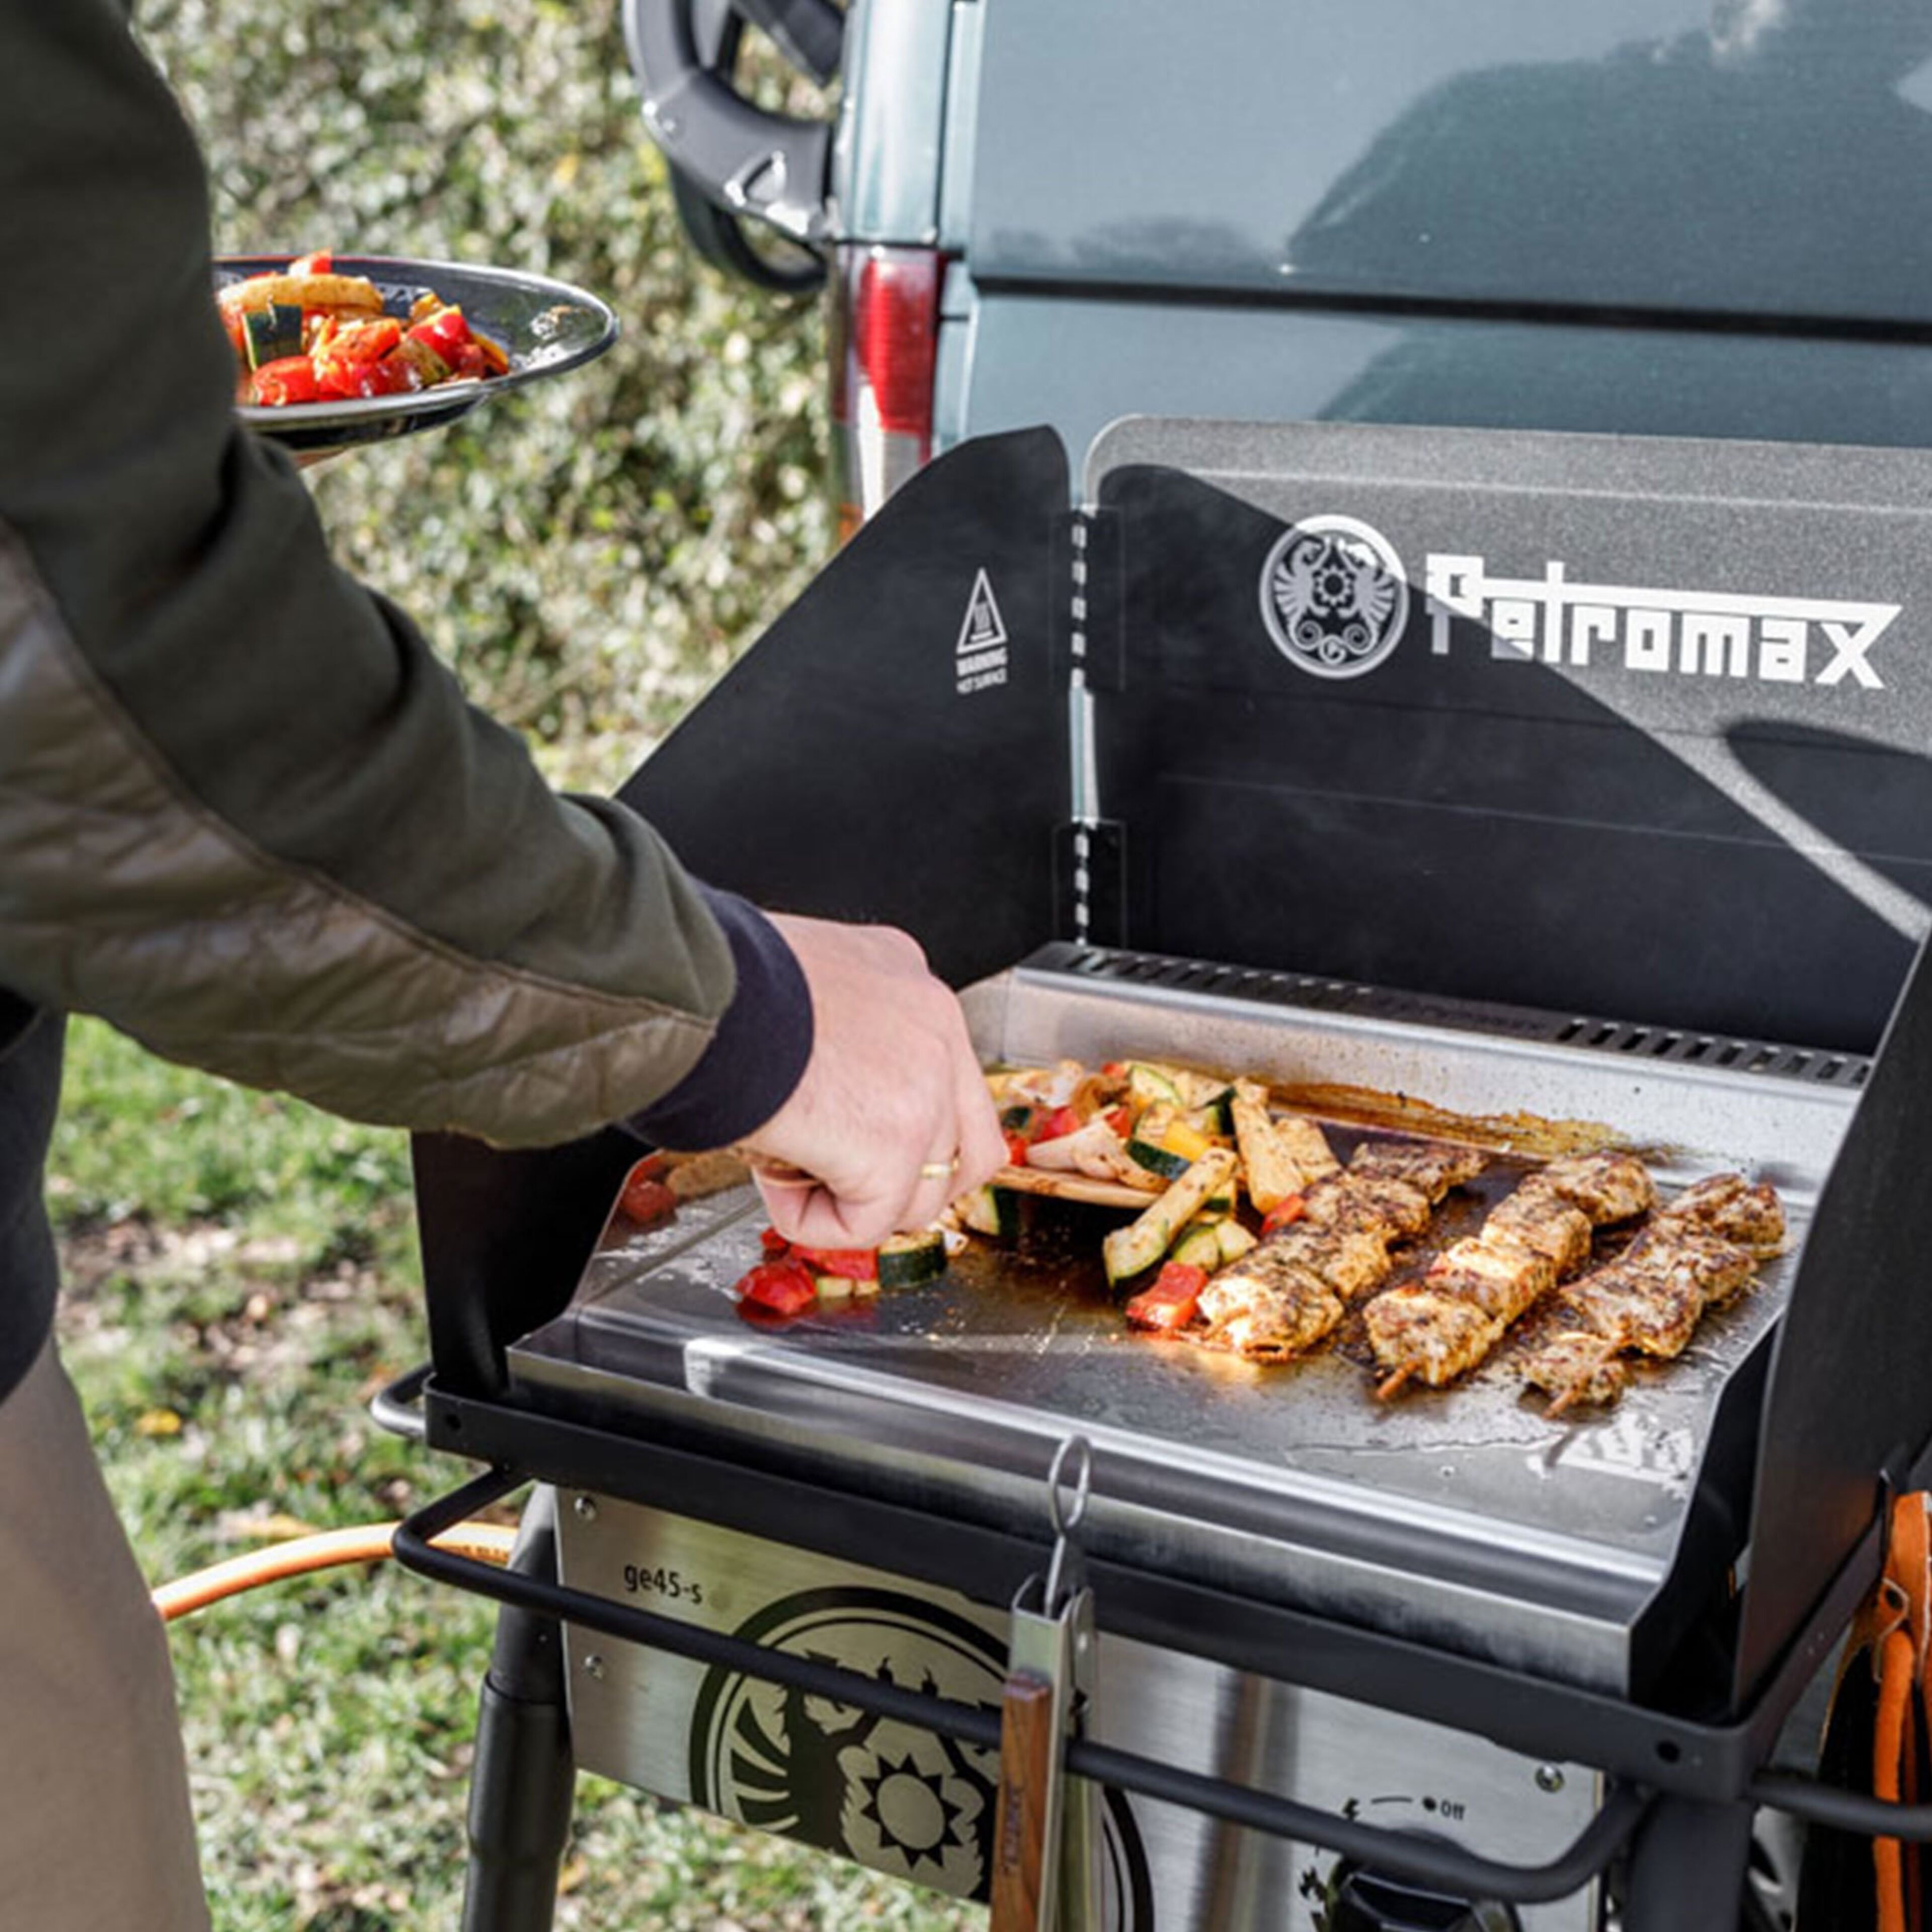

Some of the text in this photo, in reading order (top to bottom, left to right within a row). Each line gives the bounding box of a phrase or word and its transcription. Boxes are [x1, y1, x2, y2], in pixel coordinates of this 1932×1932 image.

[1425, 554, 1903, 688] Petromax
[623, 1564, 702, 1605] ge45-s
[1440, 1799, 1466, 1820] Off
